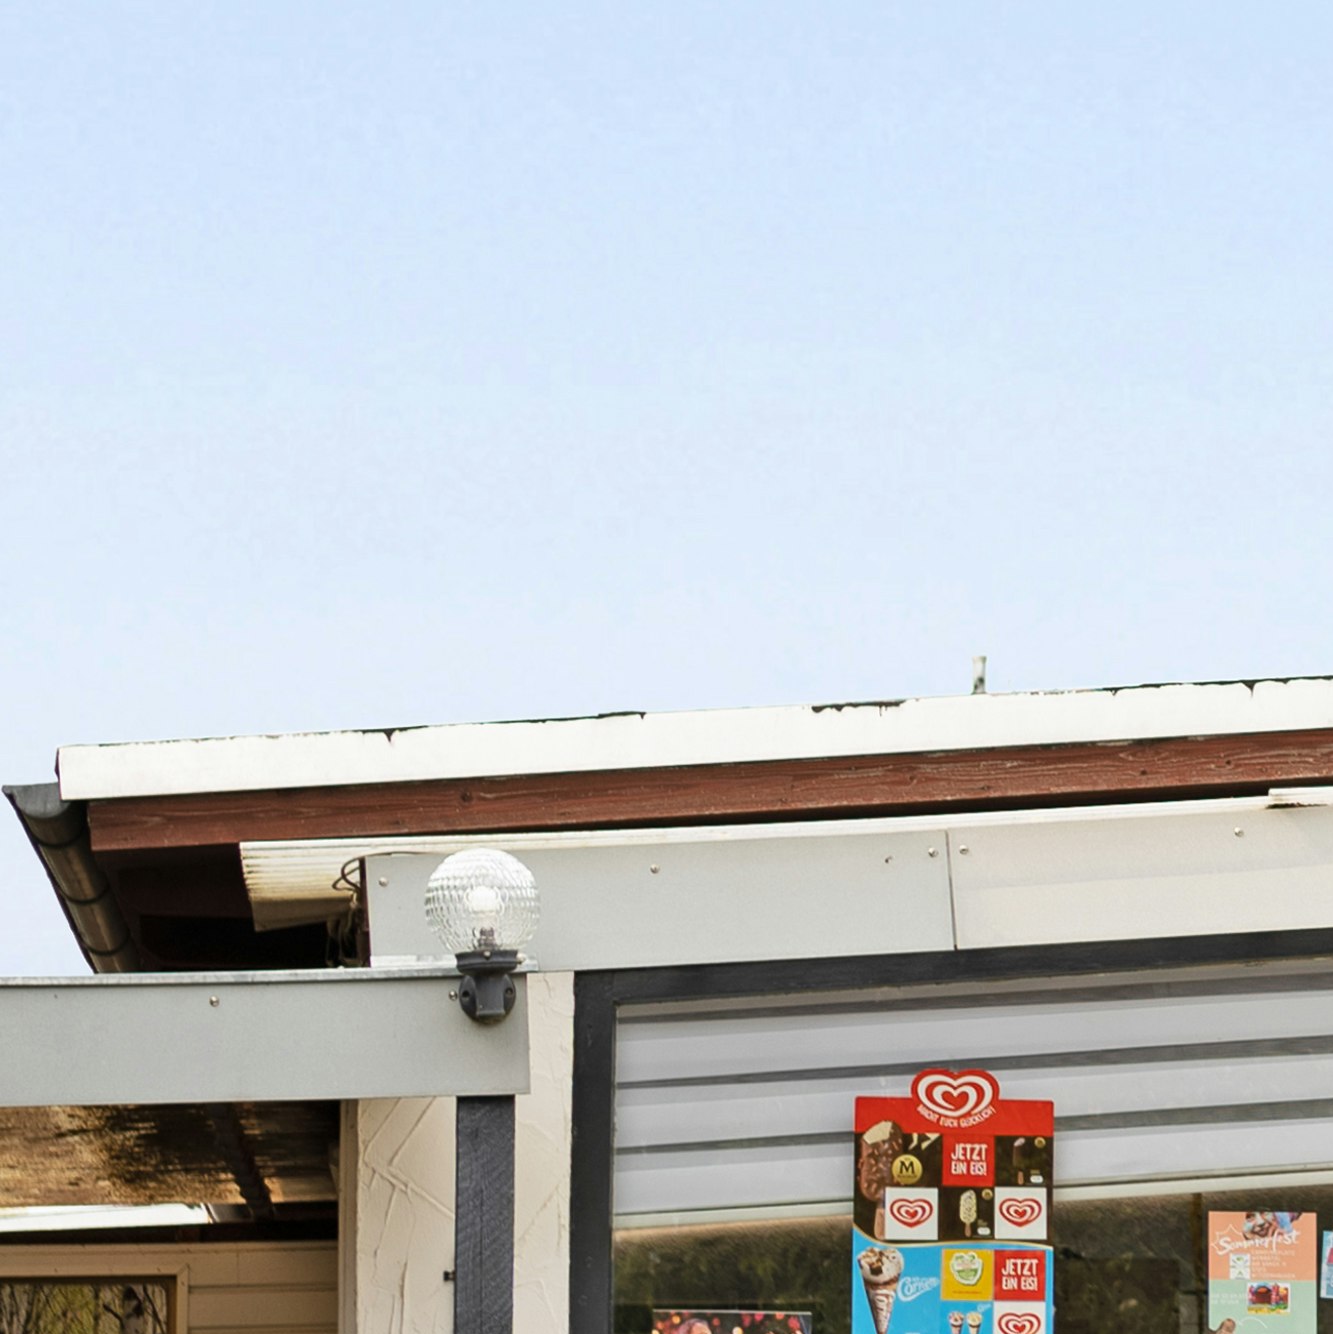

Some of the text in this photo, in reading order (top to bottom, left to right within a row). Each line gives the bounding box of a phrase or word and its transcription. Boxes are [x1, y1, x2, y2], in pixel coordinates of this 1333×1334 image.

[939, 1117, 958, 1128] EUCH
[951, 1143, 987, 1160] JETZT
[899, 1160, 915, 1174] M
[951, 1161, 987, 1176] EIN EIS!
[1217, 1229, 1299, 1255] Sommerfest
[1002, 1258, 1039, 1275] JETZT
[1002, 1277, 1038, 1291] EIN EIS!
